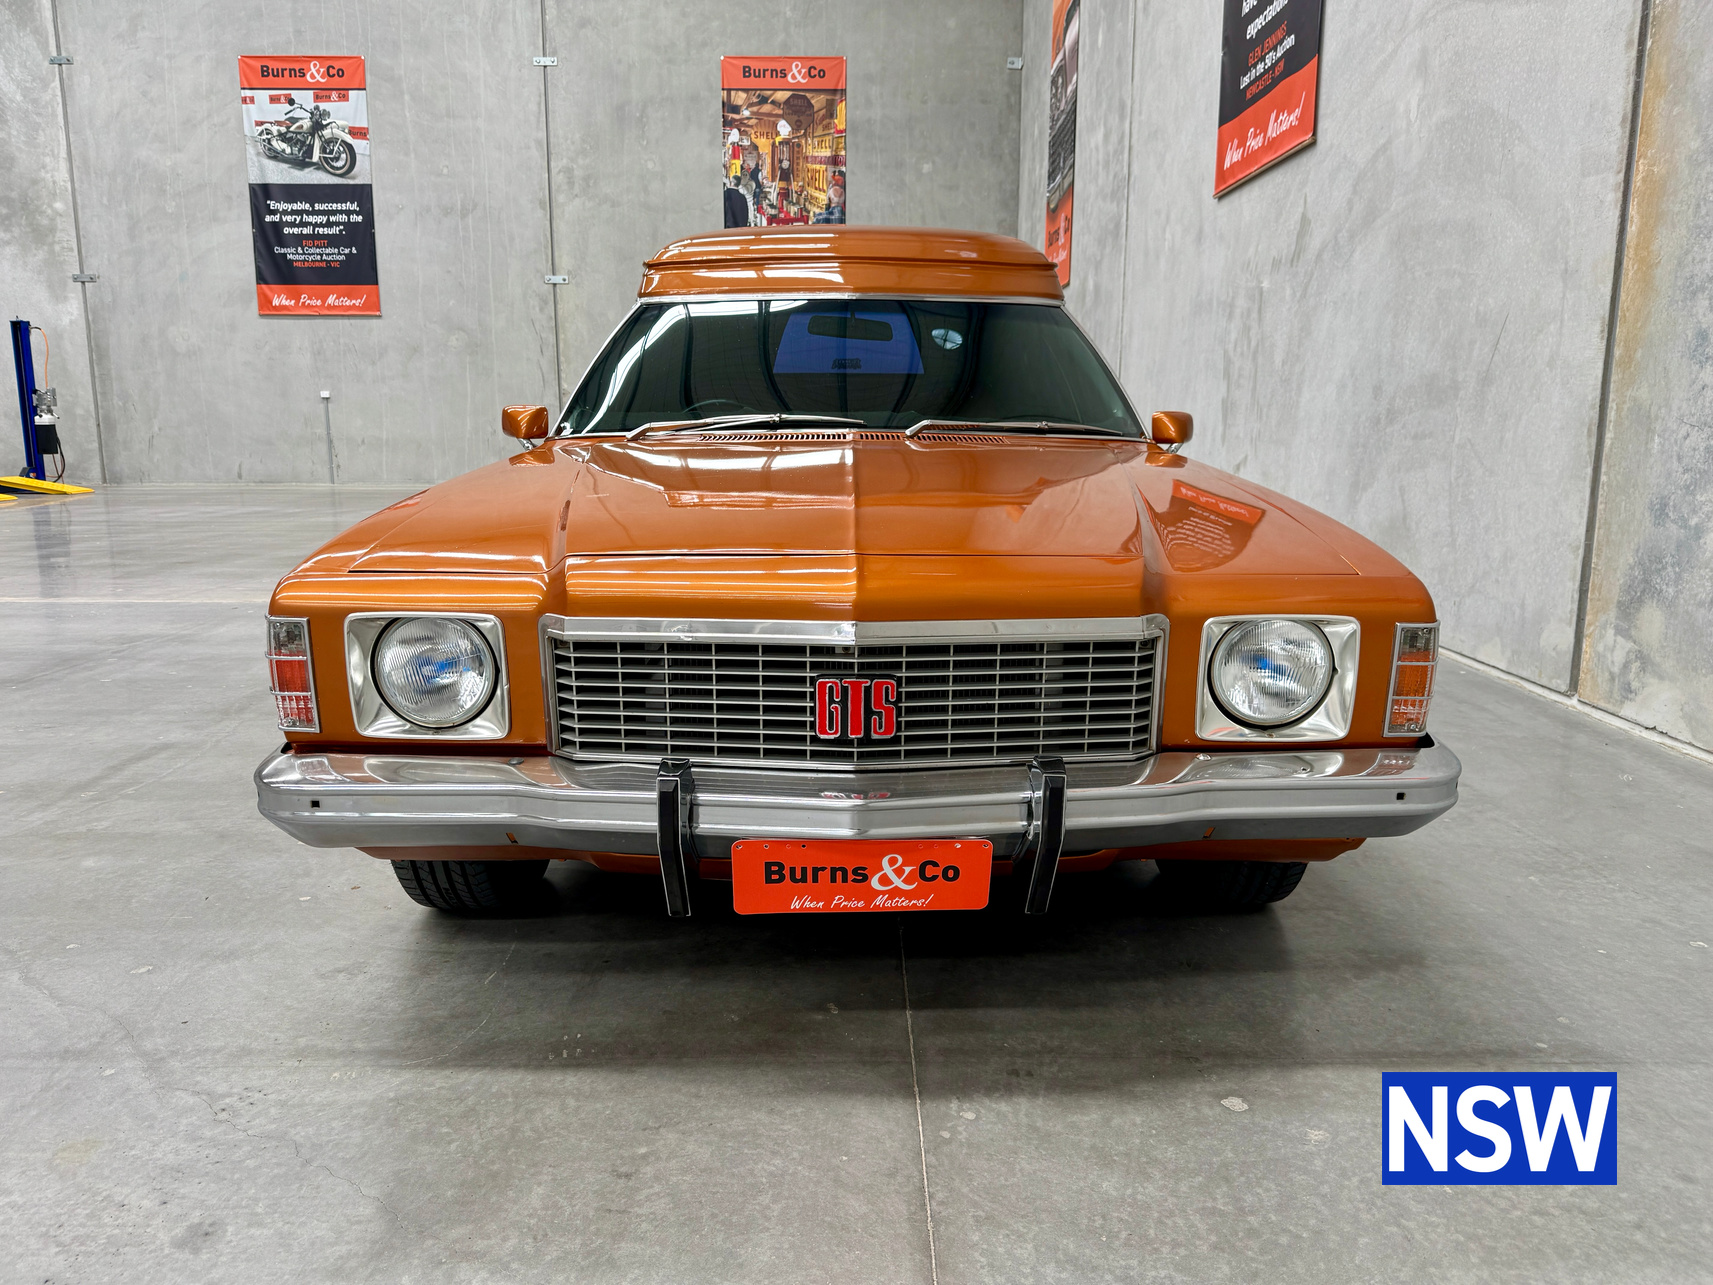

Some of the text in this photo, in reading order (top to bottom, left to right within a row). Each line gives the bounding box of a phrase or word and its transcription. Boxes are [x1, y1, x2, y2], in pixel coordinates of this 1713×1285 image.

[1248, 20, 1287, 67] GLEN JENNINGS
[260, 60, 345, 82] Burns&Co
[742, 61, 826, 83] Burns&Co
[1240, 71, 1251, 90] Lost
[1250, 67, 1256, 81] in
[1256, 61, 1265, 77] the
[1276, 33, 1295, 60] Auction
[1246, 70, 1272, 100] NEWCASTLE
[1223, 91, 1306, 171] When Price Matters!
[314, 201, 360, 211] successful,
[264, 213, 363, 224] and very happy with the
[283, 225, 313, 234] overall
[273, 246, 358, 254] Classic & Collectable Car &
[286, 253, 346, 261] Motorcycle Auction
[272, 293, 367, 307] When Price Matters!
[815, 678, 897, 739] GTS
[764, 853, 961, 891] Burns&Co
[790, 893, 935, 910] When Price Matters!
